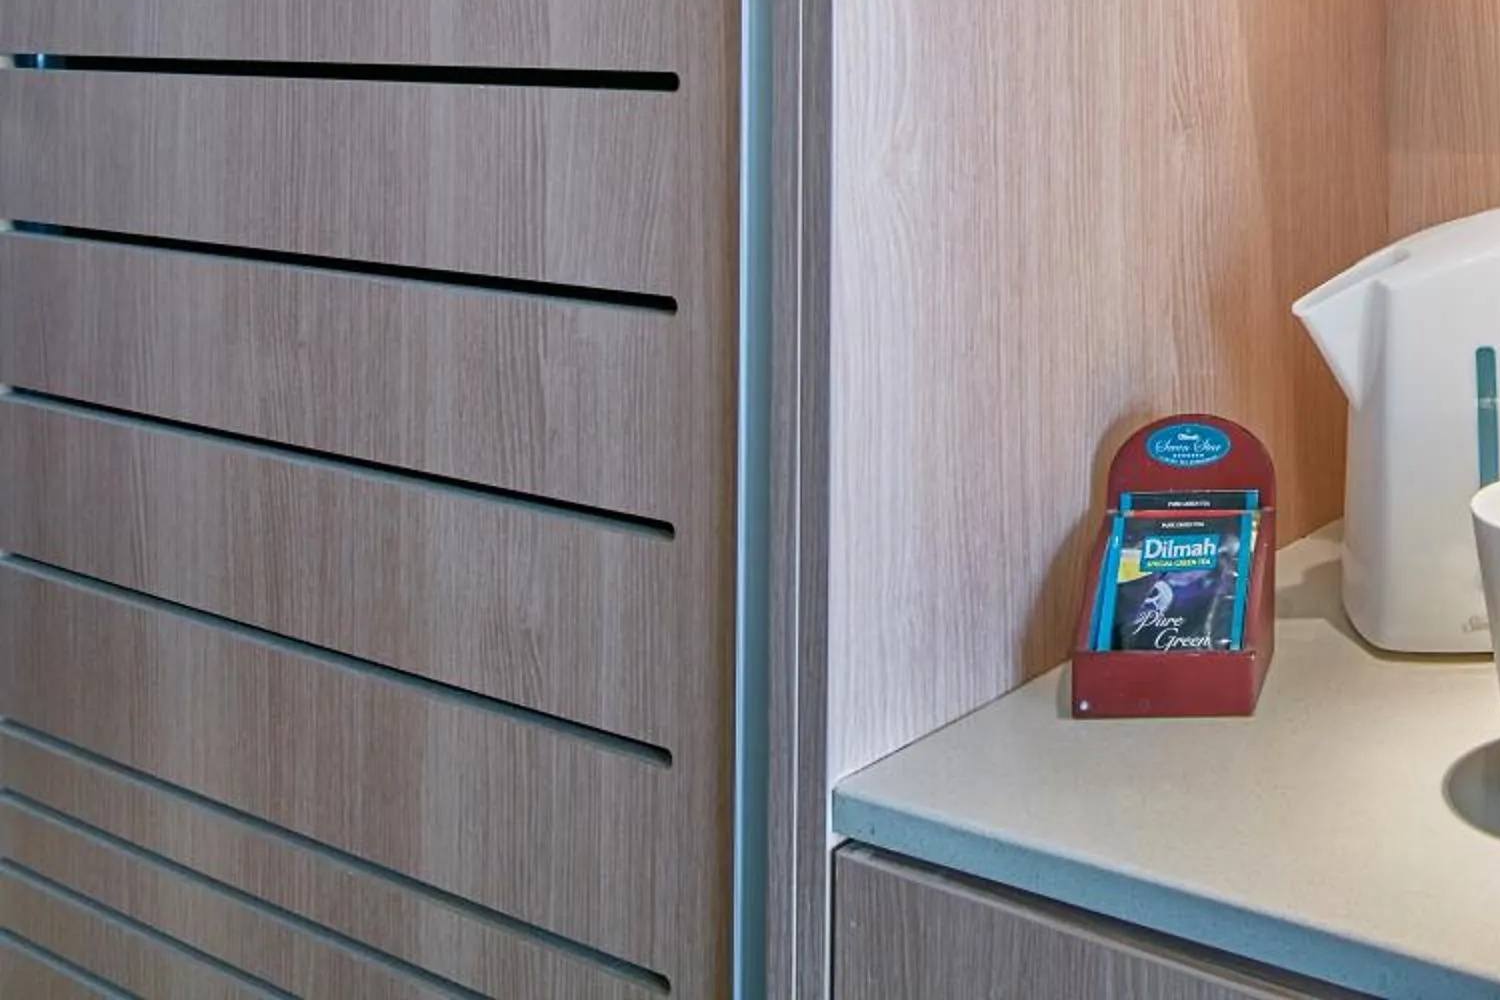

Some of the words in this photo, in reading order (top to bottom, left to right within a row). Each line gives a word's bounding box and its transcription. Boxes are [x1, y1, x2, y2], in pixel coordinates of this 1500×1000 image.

[1144, 537, 1216, 559] Dilmah
[1132, 610, 1184, 635] Pure
[1154, 627, 1212, 651] Green
